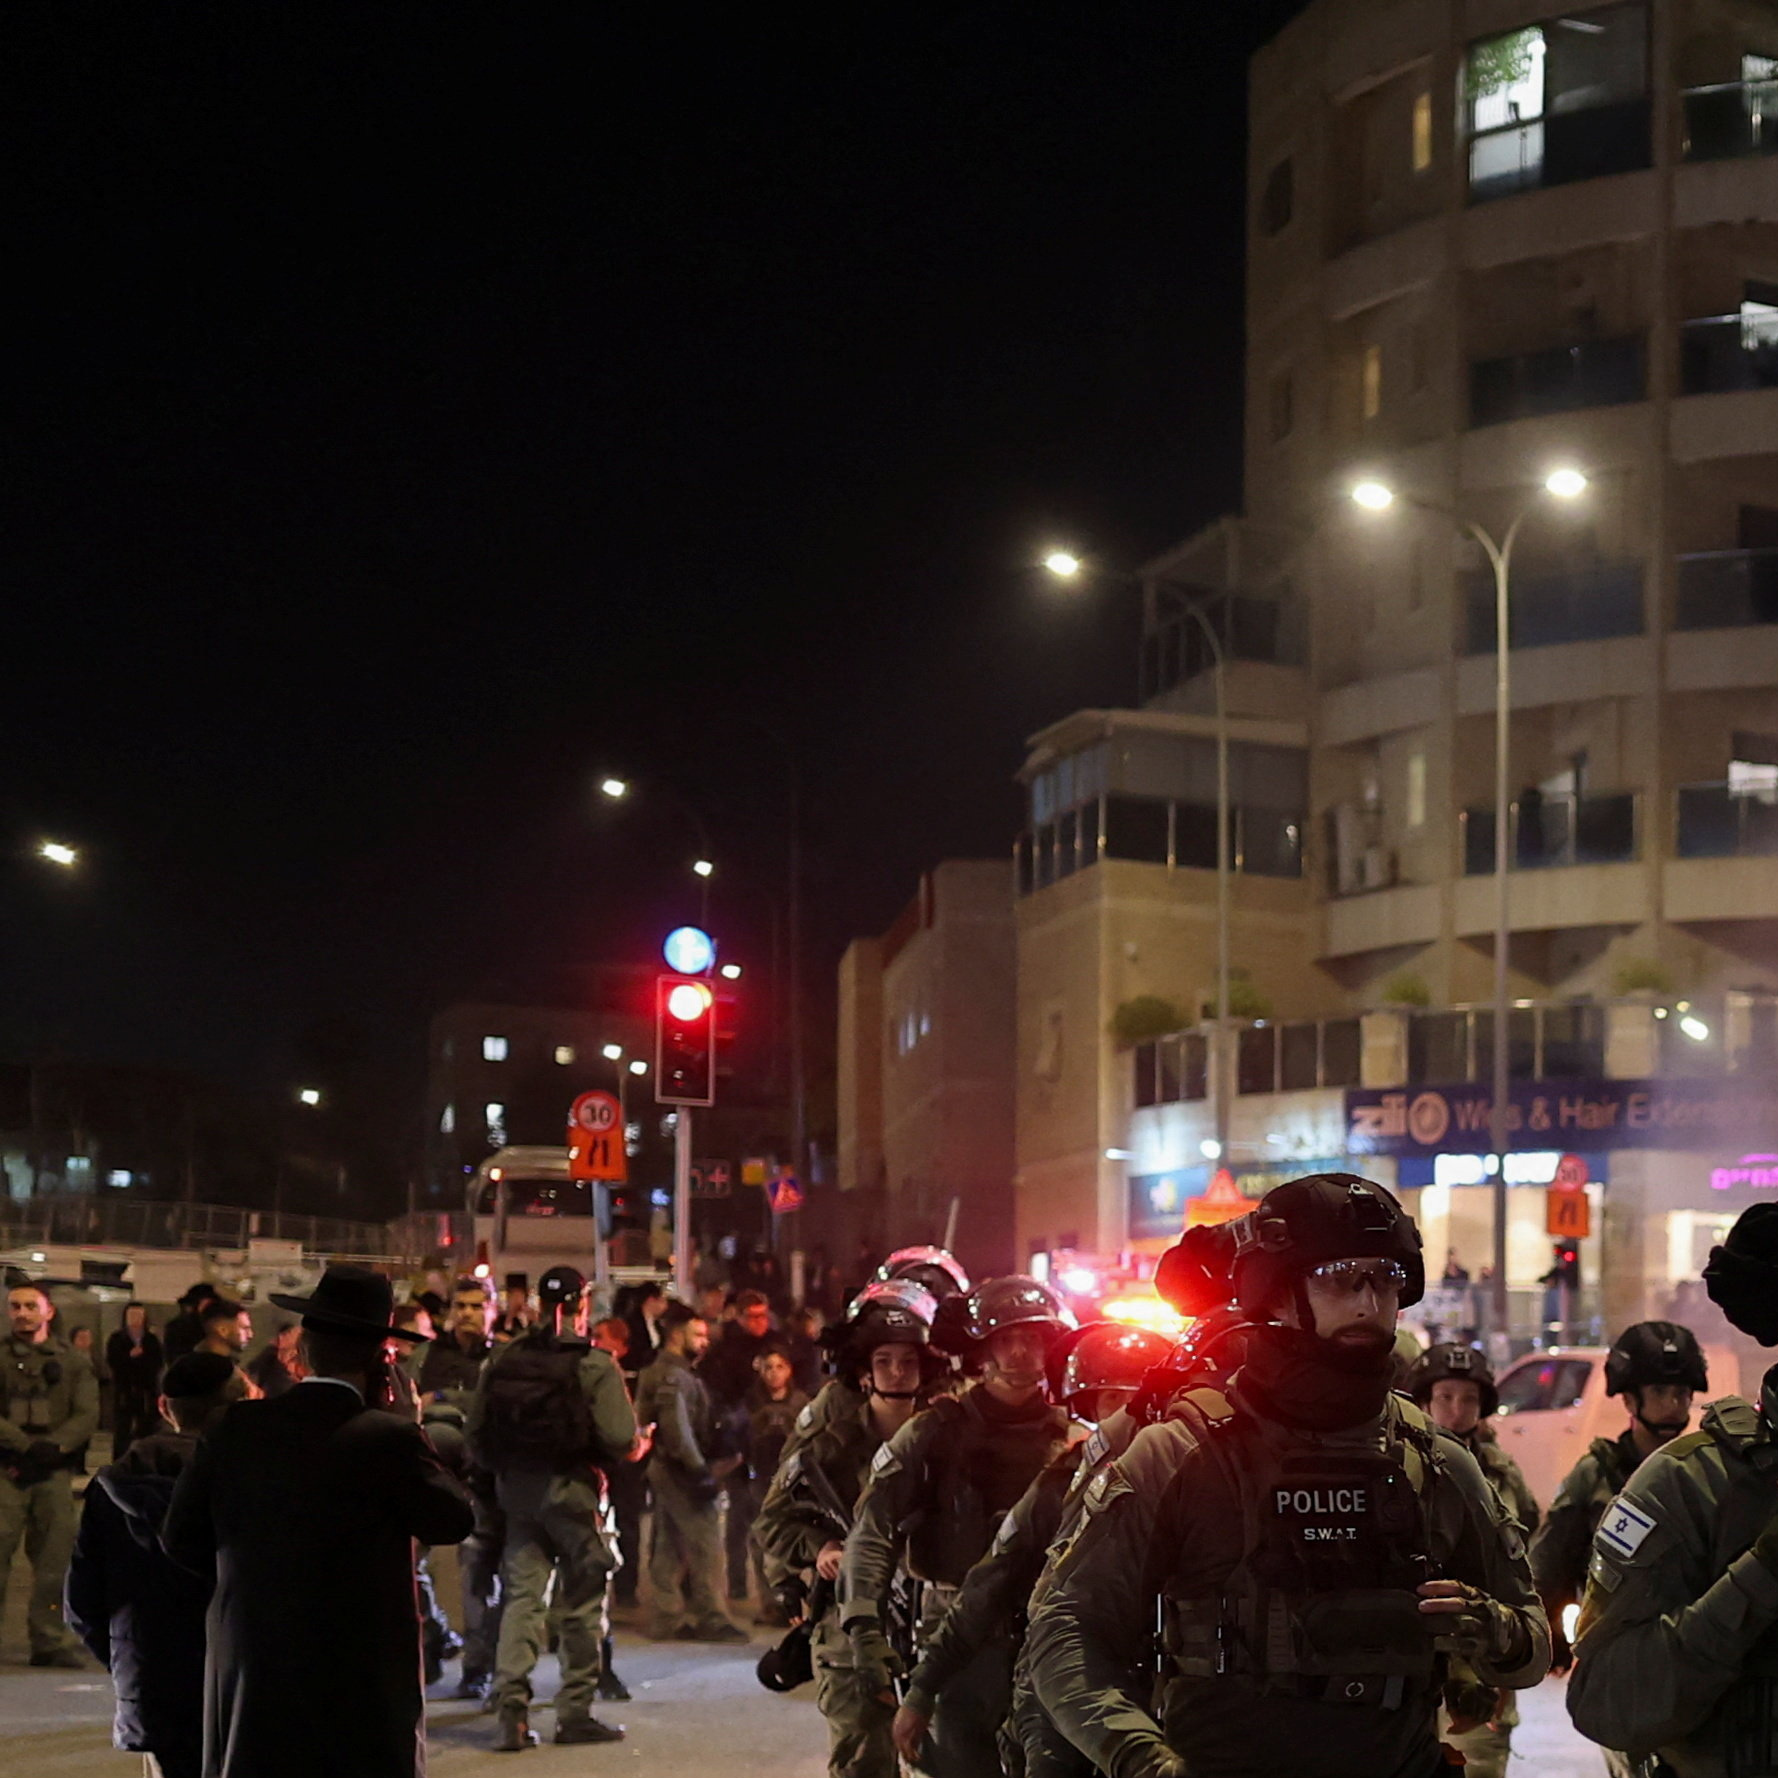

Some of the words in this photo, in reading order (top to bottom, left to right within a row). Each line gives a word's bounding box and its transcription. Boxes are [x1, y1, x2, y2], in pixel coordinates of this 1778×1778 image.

[584, 1103, 613, 1125] 30
[1453, 1099, 1521, 1132] Wis
[1528, 1095, 1551, 1132] &
[1559, 1094, 1620, 1130] Hair
[1276, 1489, 1366, 1514] POLICE
